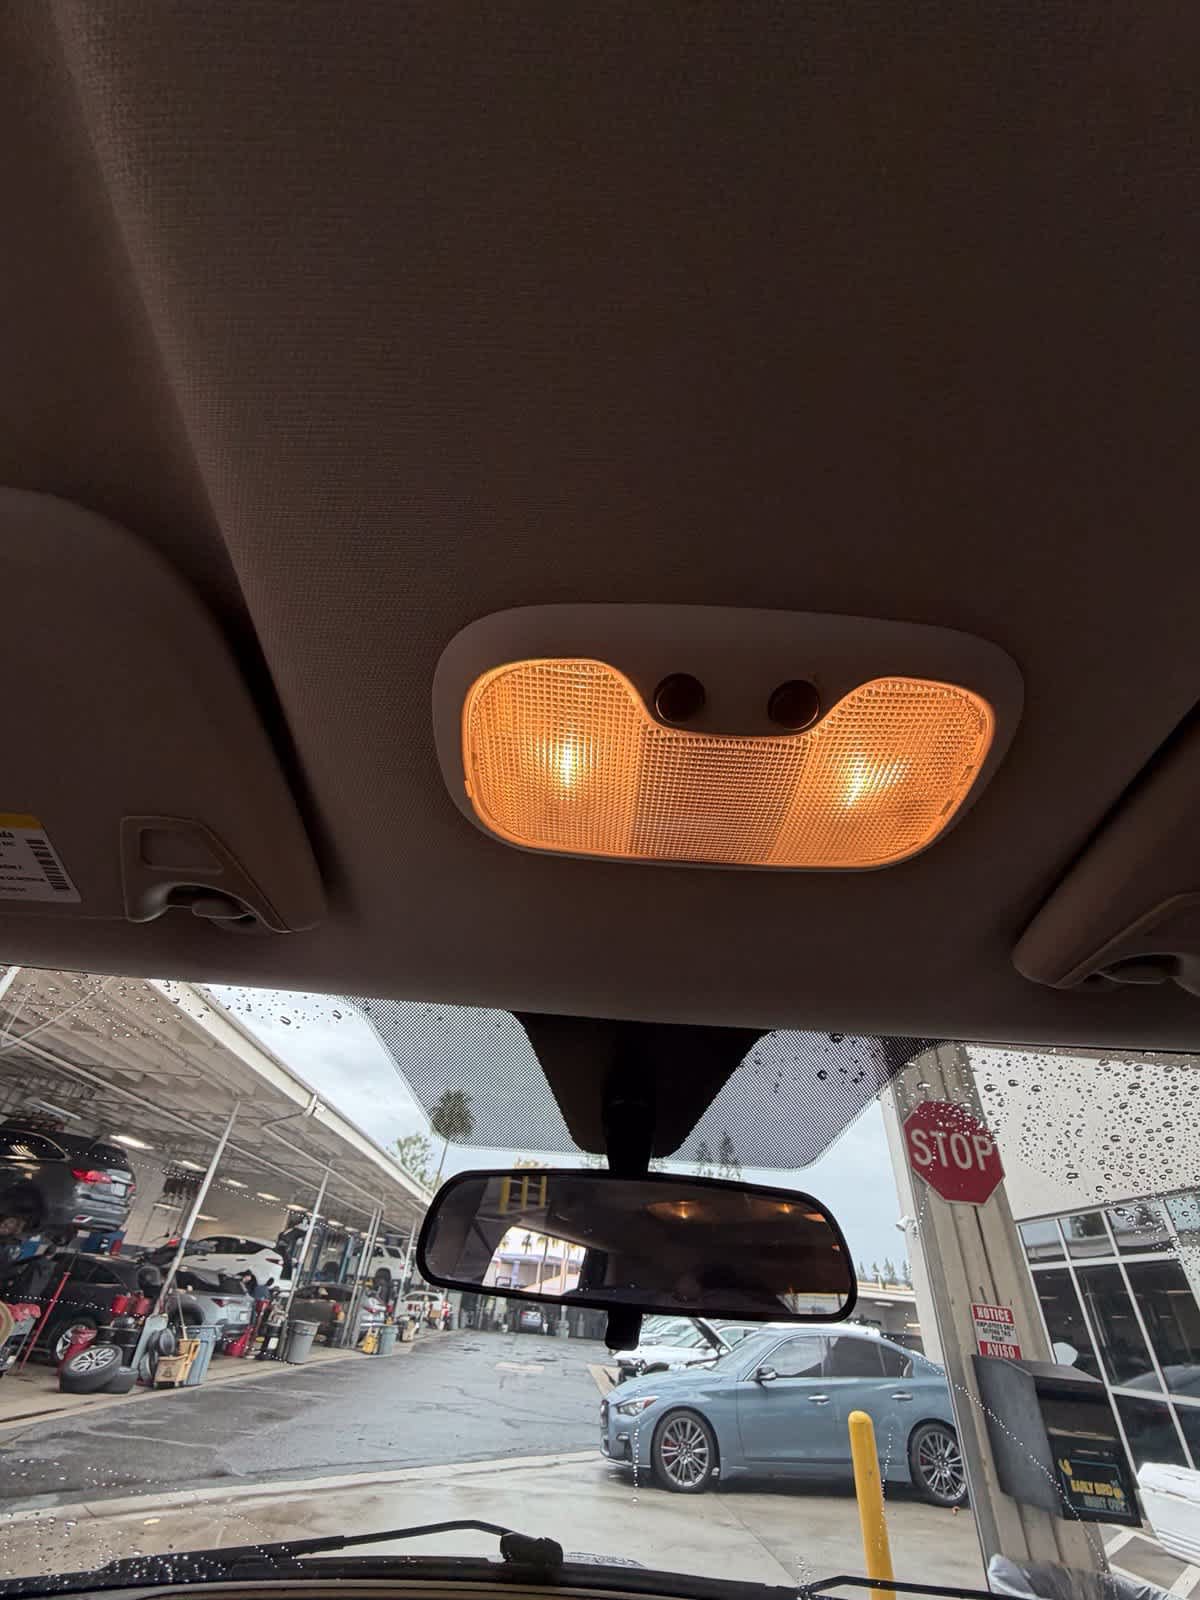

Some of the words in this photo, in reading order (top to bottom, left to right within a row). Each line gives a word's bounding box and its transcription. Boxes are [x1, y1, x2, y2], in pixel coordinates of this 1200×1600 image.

[911, 1128, 993, 1171] STOP
[976, 1306, 1011, 1322] NOTICE
[987, 1342, 1016, 1360] AVISO
